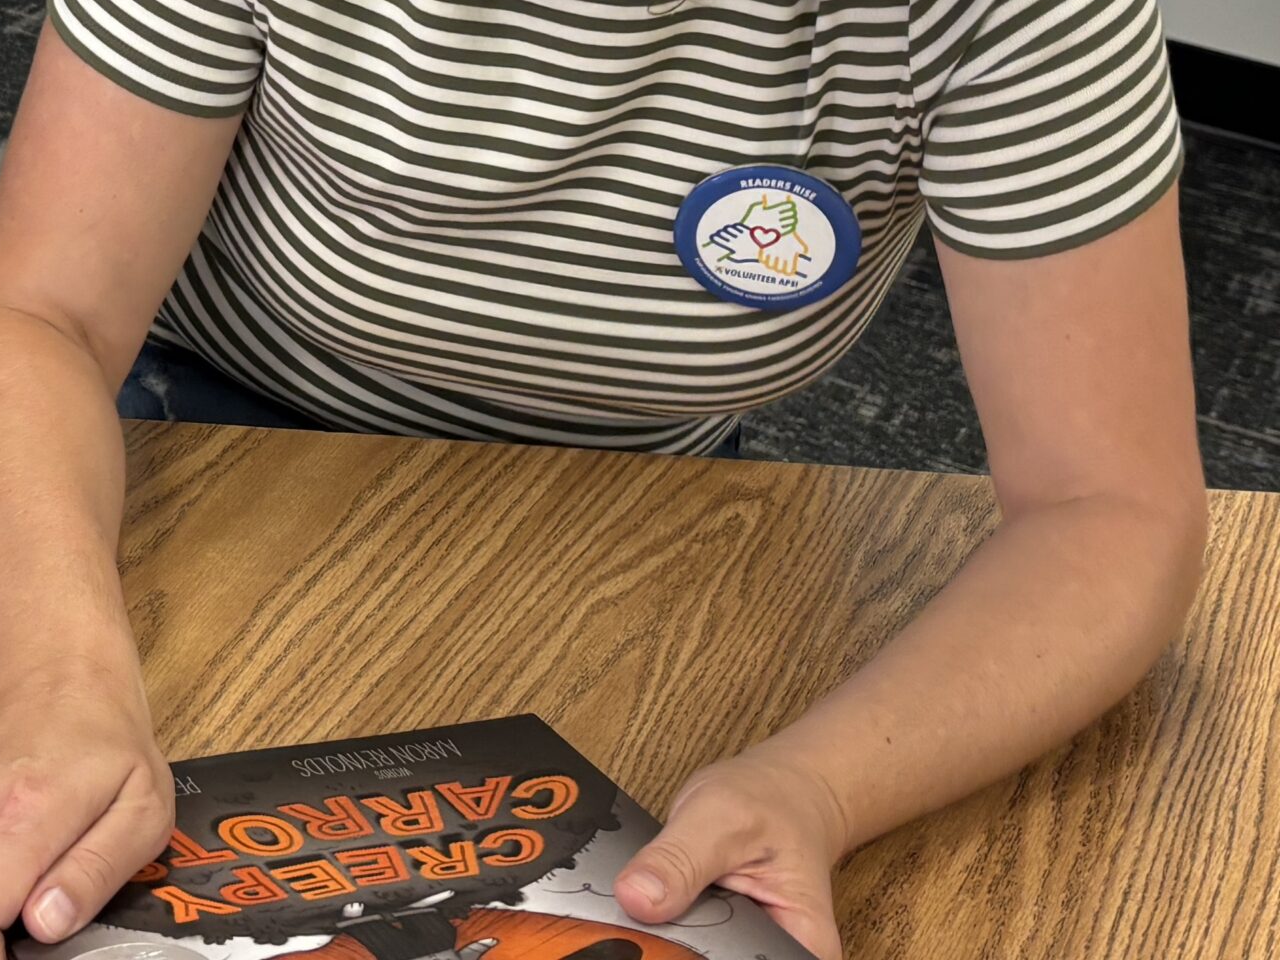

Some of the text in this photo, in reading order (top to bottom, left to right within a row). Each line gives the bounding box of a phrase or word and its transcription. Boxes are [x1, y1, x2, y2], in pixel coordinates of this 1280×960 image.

[739, 178, 818, 201] READERS RISE
[724, 267, 777, 285] VOLUNTEER
[291, 738, 462, 777] AARON REYNOLDS
[152, 827, 545, 924] CREEPY
